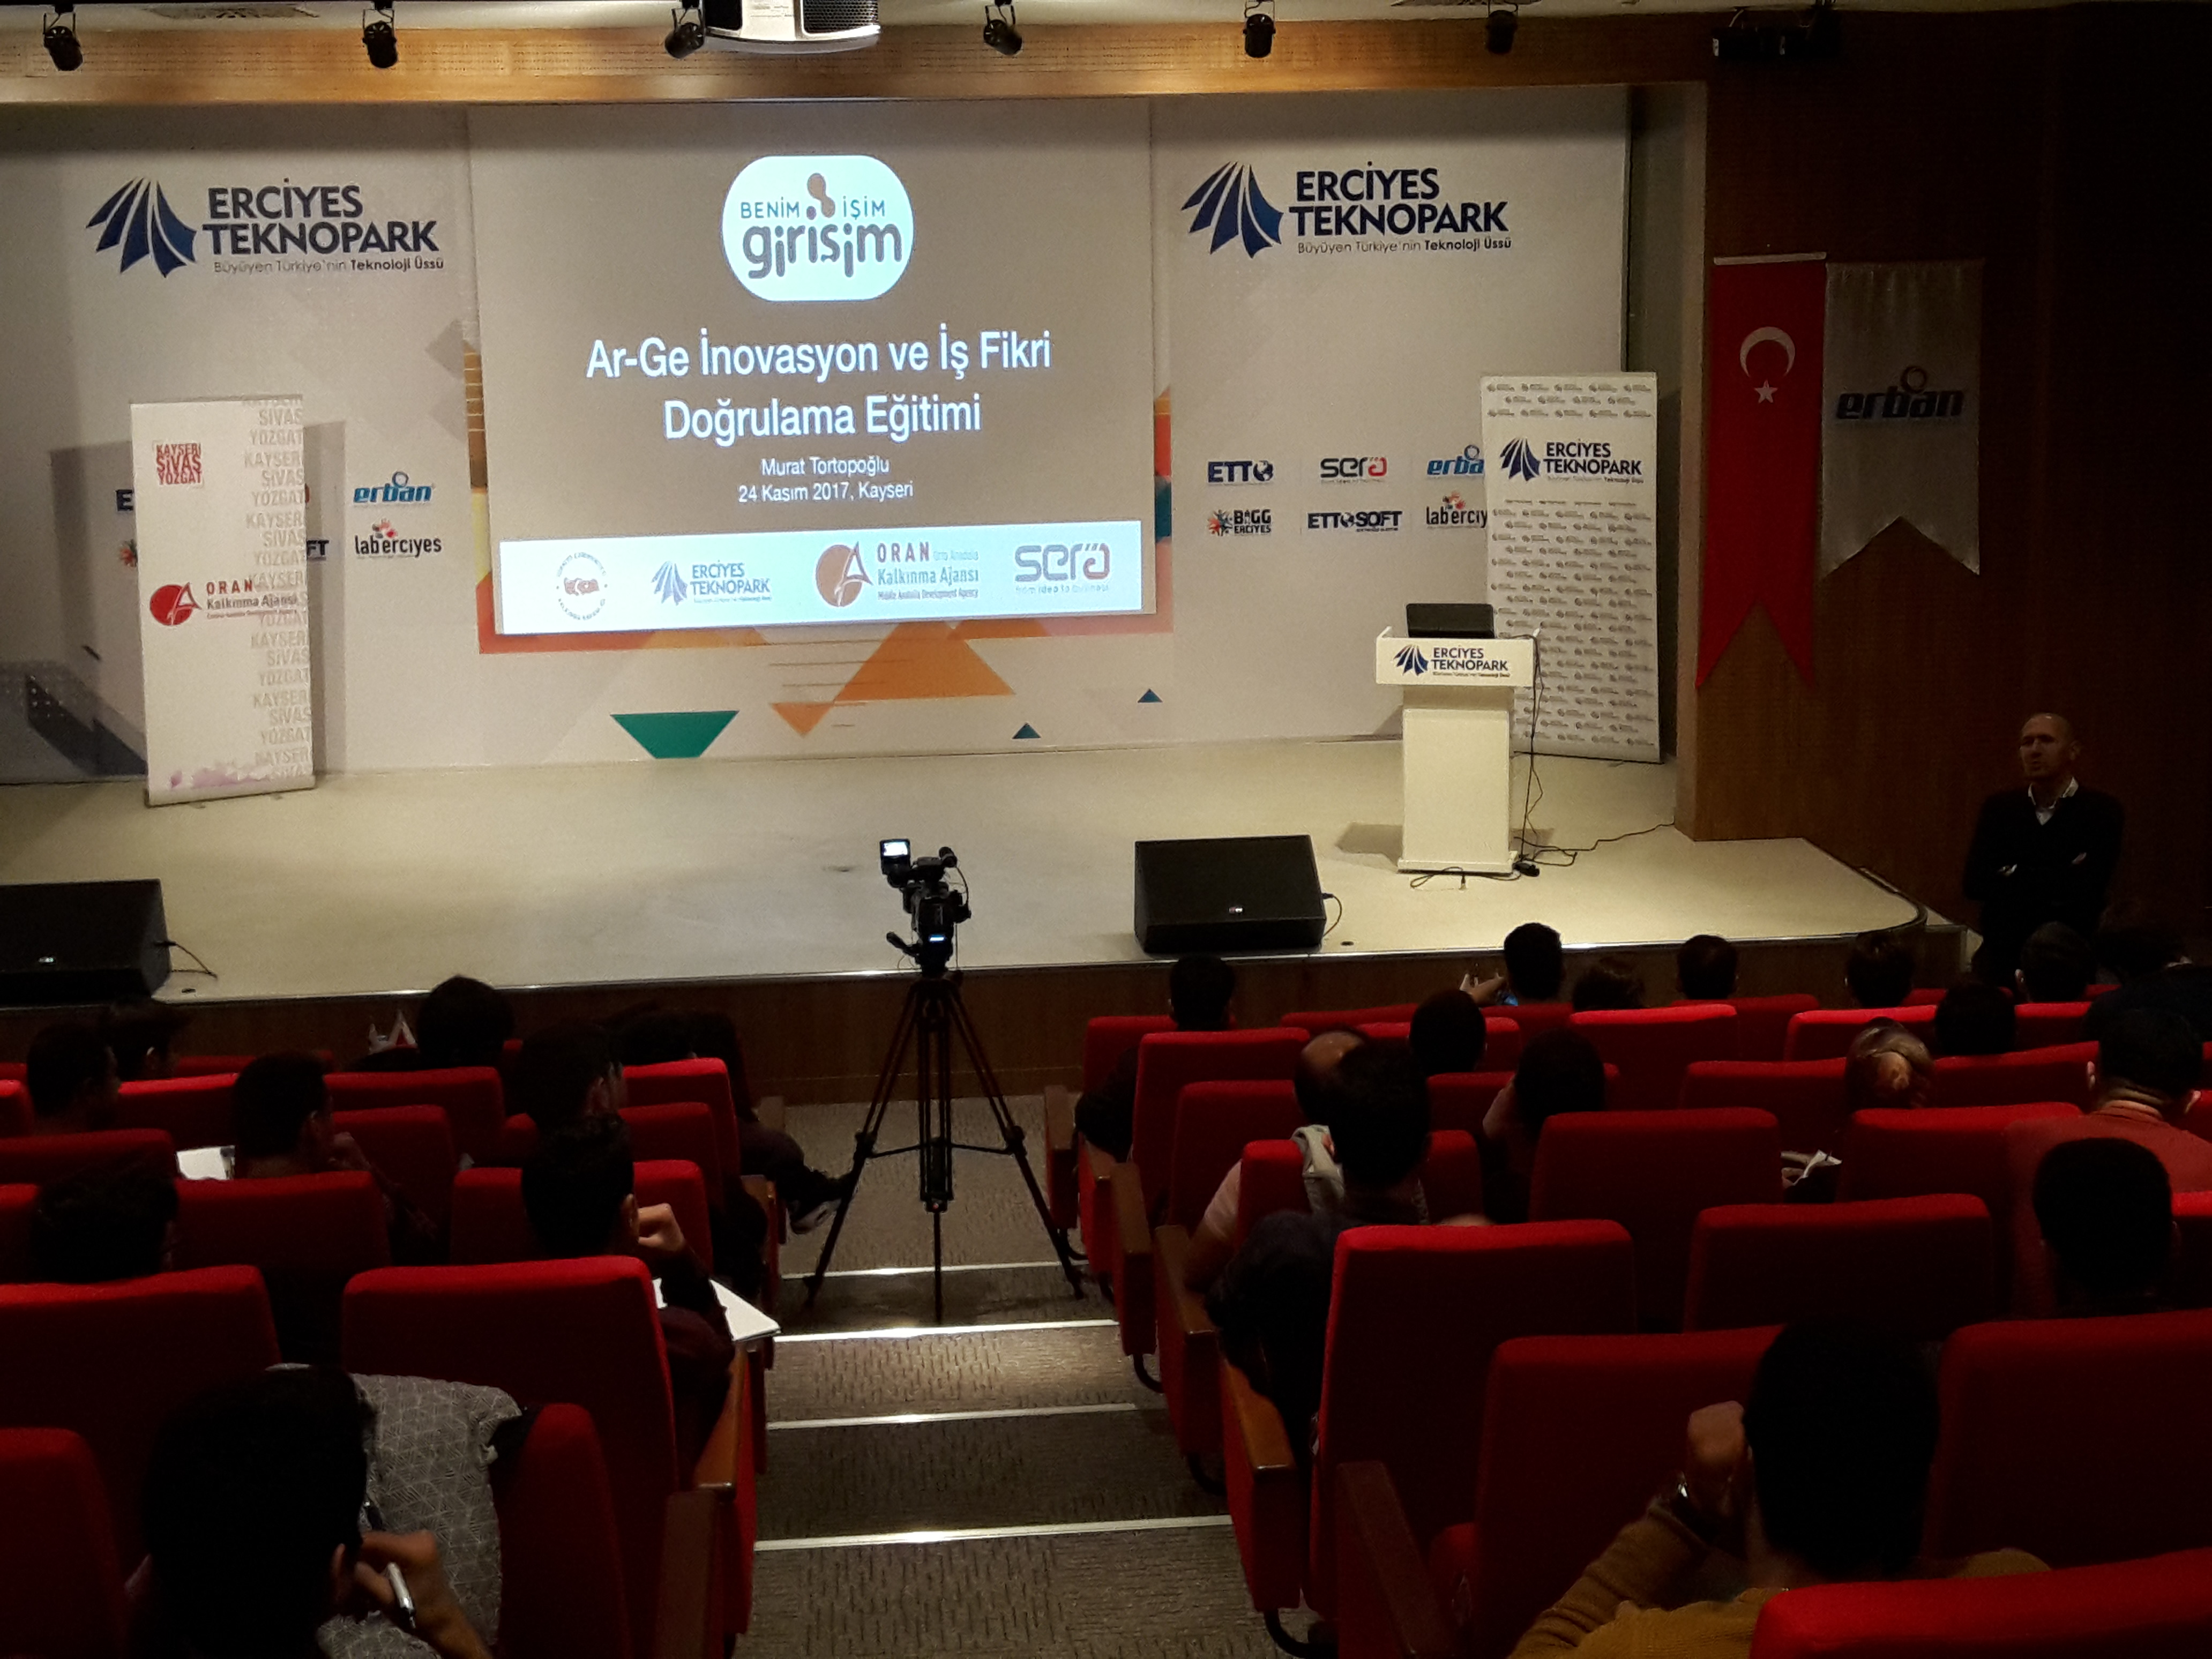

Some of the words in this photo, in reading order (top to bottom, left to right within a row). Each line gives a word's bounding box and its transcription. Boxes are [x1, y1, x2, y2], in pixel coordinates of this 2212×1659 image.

[1296, 161, 1440, 201] ERCİYES
[208, 177, 363, 219] ERCİYES
[740, 196, 801, 219] BENİM
[843, 195, 885, 221] İŞİM
[1288, 201, 1509, 236] TEKNOPARK
[202, 221, 440, 255] TEKNOPARK
[586, 337, 690, 378] Ar-Ge
[700, 327, 879, 383] İnovasyon
[887, 341, 929, 371] ve
[939, 322, 969, 380] İş
[980, 329, 1051, 369] Fikri
[1836, 386, 1964, 419] erban
[663, 398, 856, 447] Doğrulama
[865, 392, 982, 443] Eğitimi
[761, 458, 805, 476] Murat
[809, 455, 890, 477] Tortopoğlu
[1427, 455, 1485, 475] erba
[1543, 459, 1642, 475] TEKNOPARK
[353, 482, 432, 503] erban
[738, 485, 757, 503] 24
[761, 484, 808, 502] Kasım
[813, 482, 854, 501] 2017,
[858, 480, 914, 503] Kayseri
[877, 541, 930, 563] ORAN
[206, 580, 253, 595] ORAN
[690, 578, 771, 596] TEKNOPARK
[1431, 659, 1509, 671] TEKNOPARK
